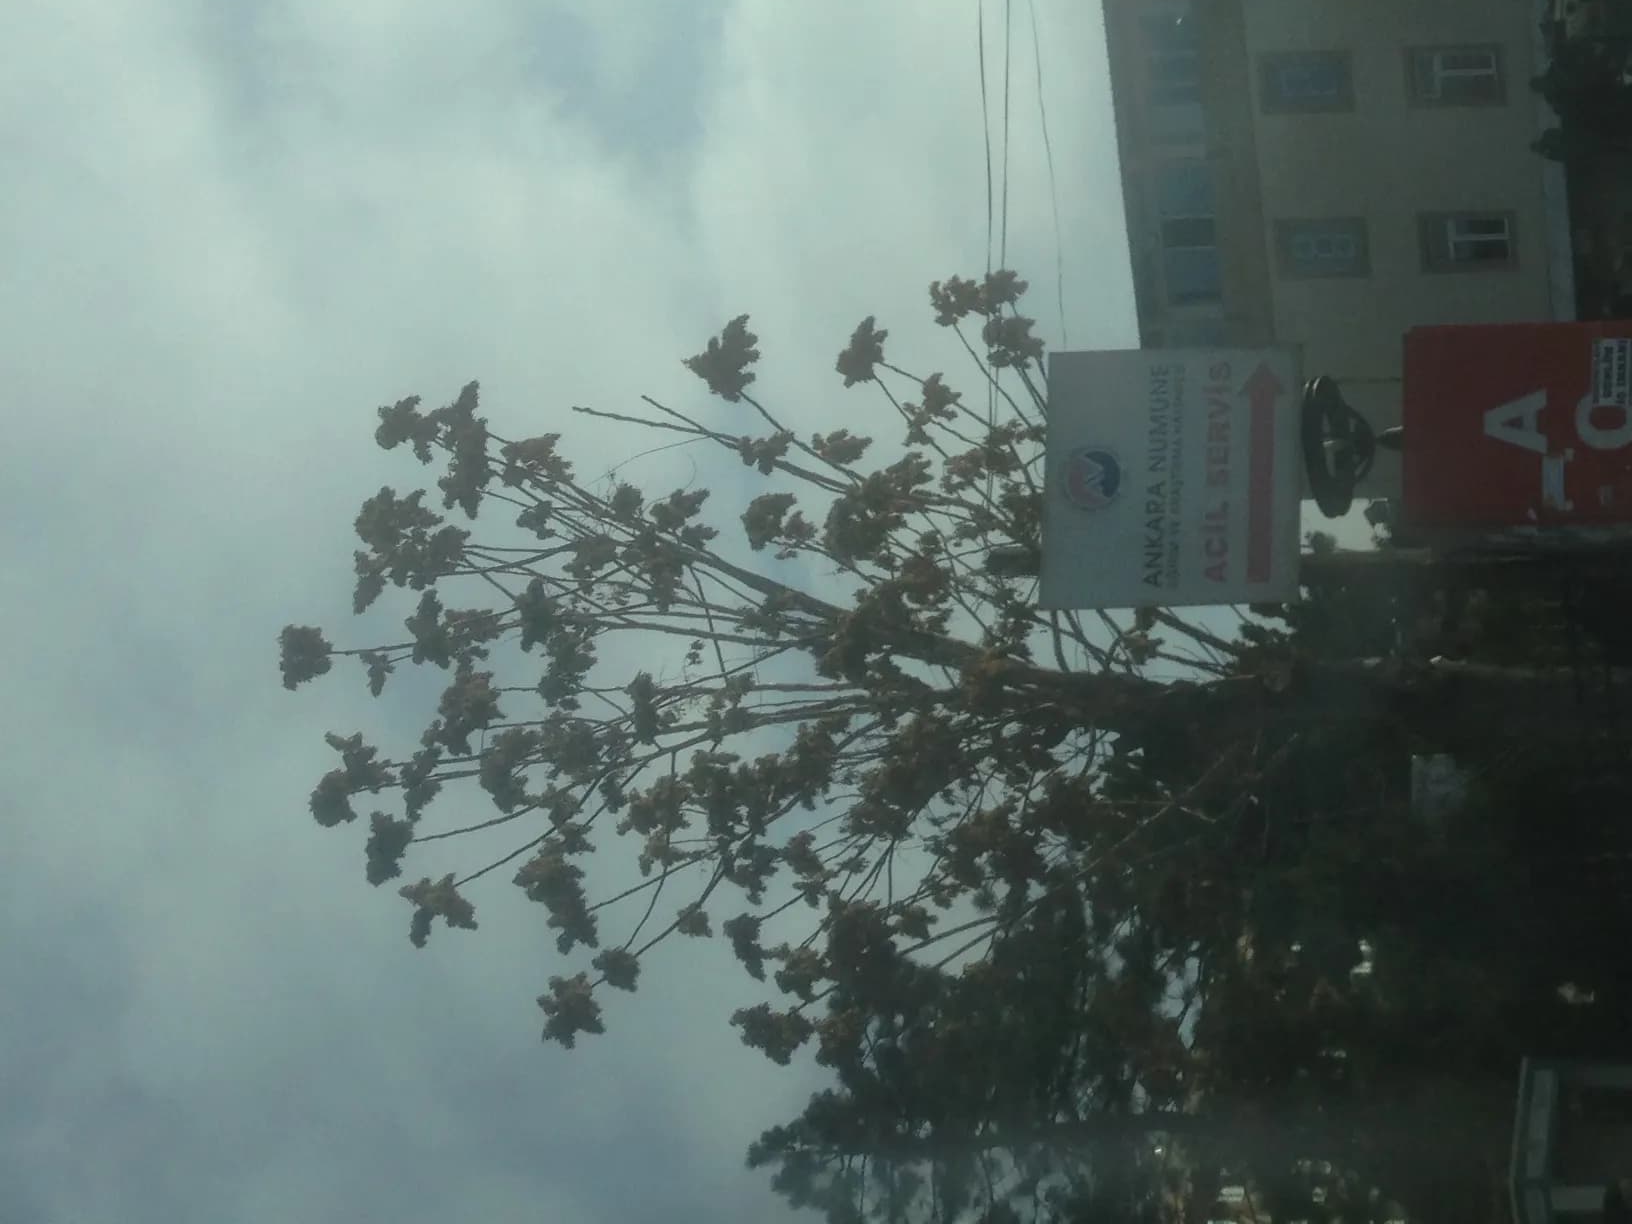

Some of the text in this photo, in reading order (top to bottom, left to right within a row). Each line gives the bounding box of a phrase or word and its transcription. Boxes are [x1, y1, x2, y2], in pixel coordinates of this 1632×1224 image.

[1143, 365, 1170, 588] ANKARA NUMUNE
[1199, 361, 1232, 584] ACİL SERVİS
